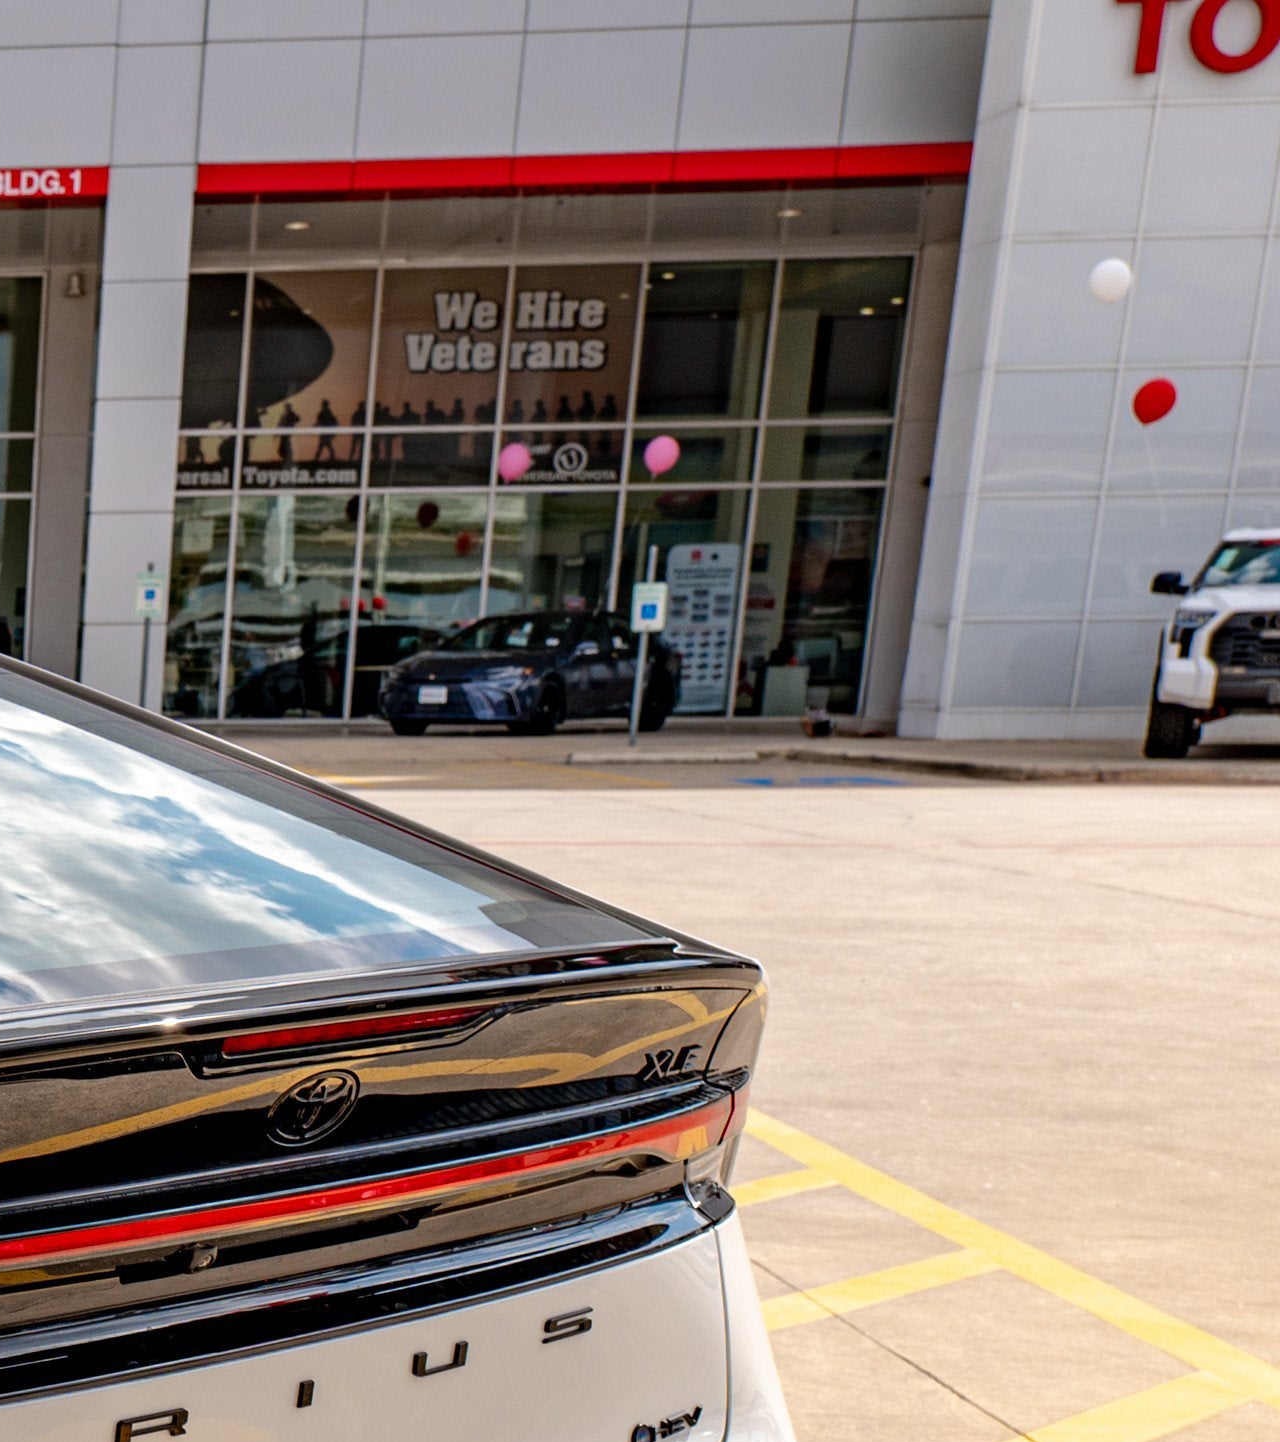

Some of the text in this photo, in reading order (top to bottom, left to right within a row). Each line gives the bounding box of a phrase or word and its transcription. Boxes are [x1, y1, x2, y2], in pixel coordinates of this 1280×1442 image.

[1116, 0, 1280, 74] TO
[69, 169, 82, 194] 1
[434, 290, 606, 331] We Hire
[404, 333, 606, 372] Veterans
[643, 1044, 703, 1081] XLE
[657, 1405, 703, 1439] HEV
